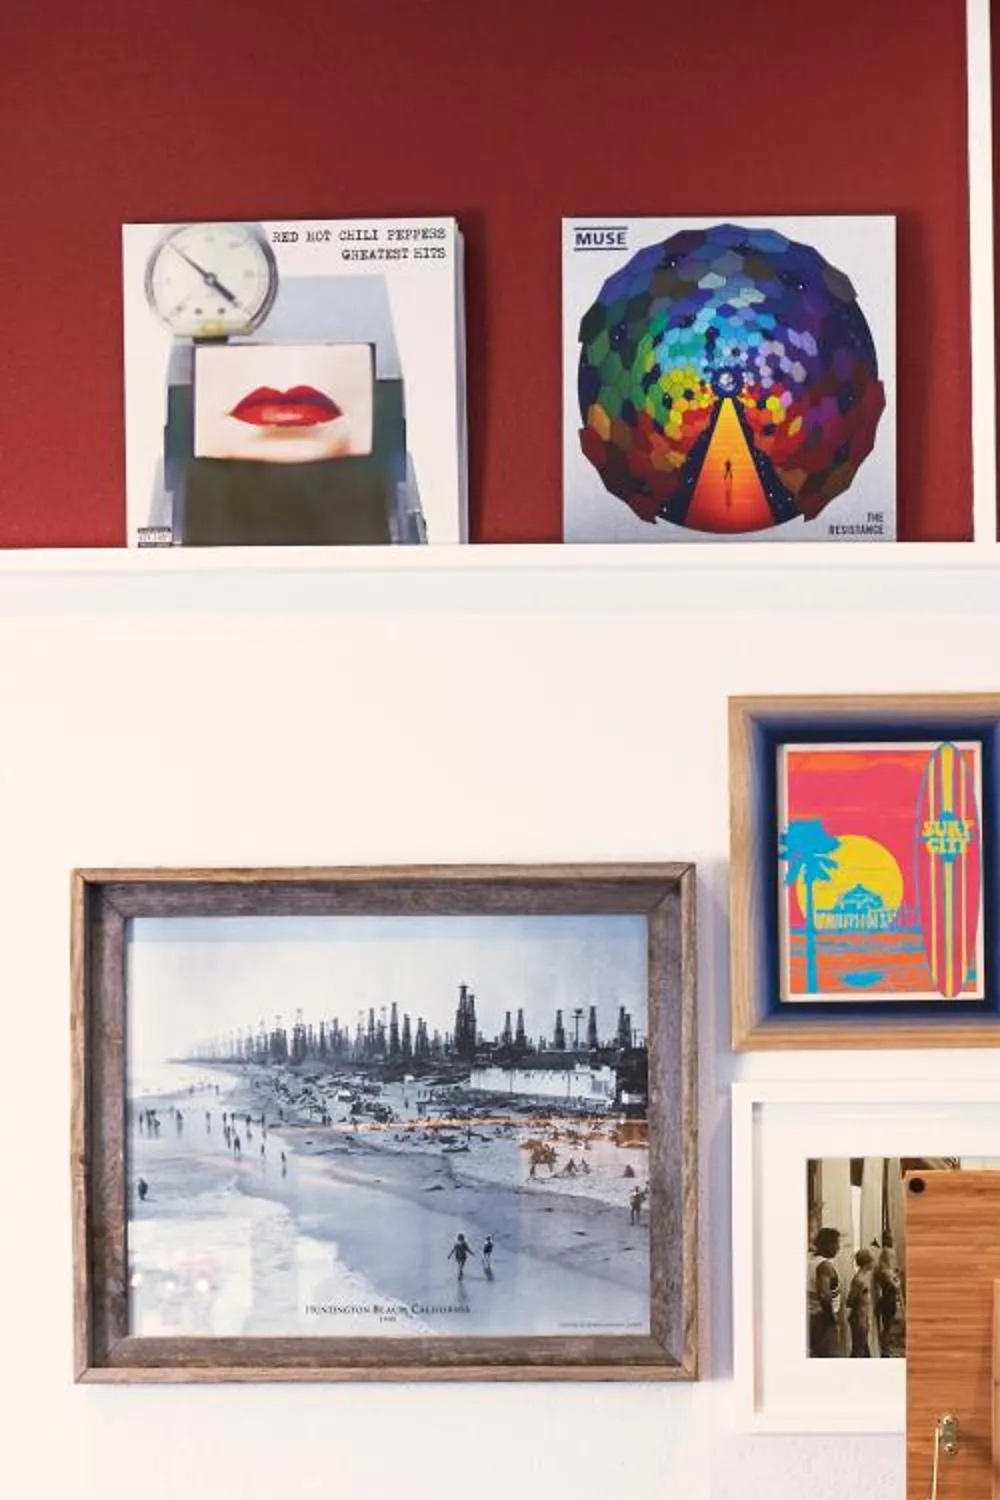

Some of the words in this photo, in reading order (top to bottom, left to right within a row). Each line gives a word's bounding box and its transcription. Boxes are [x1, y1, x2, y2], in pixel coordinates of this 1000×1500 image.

[272, 231, 299, 243] RED
[306, 231, 332, 242] HOT
[338, 229, 379, 241] CHILI
[387, 227, 447, 241] PEPPERS
[575, 231, 627, 245] MUSE
[341, 247, 409, 261] GREATEST
[413, 247, 447, 260] HITS
[867, 511, 884, 523] THE
[828, 524, 884, 535] RESISTANCE
